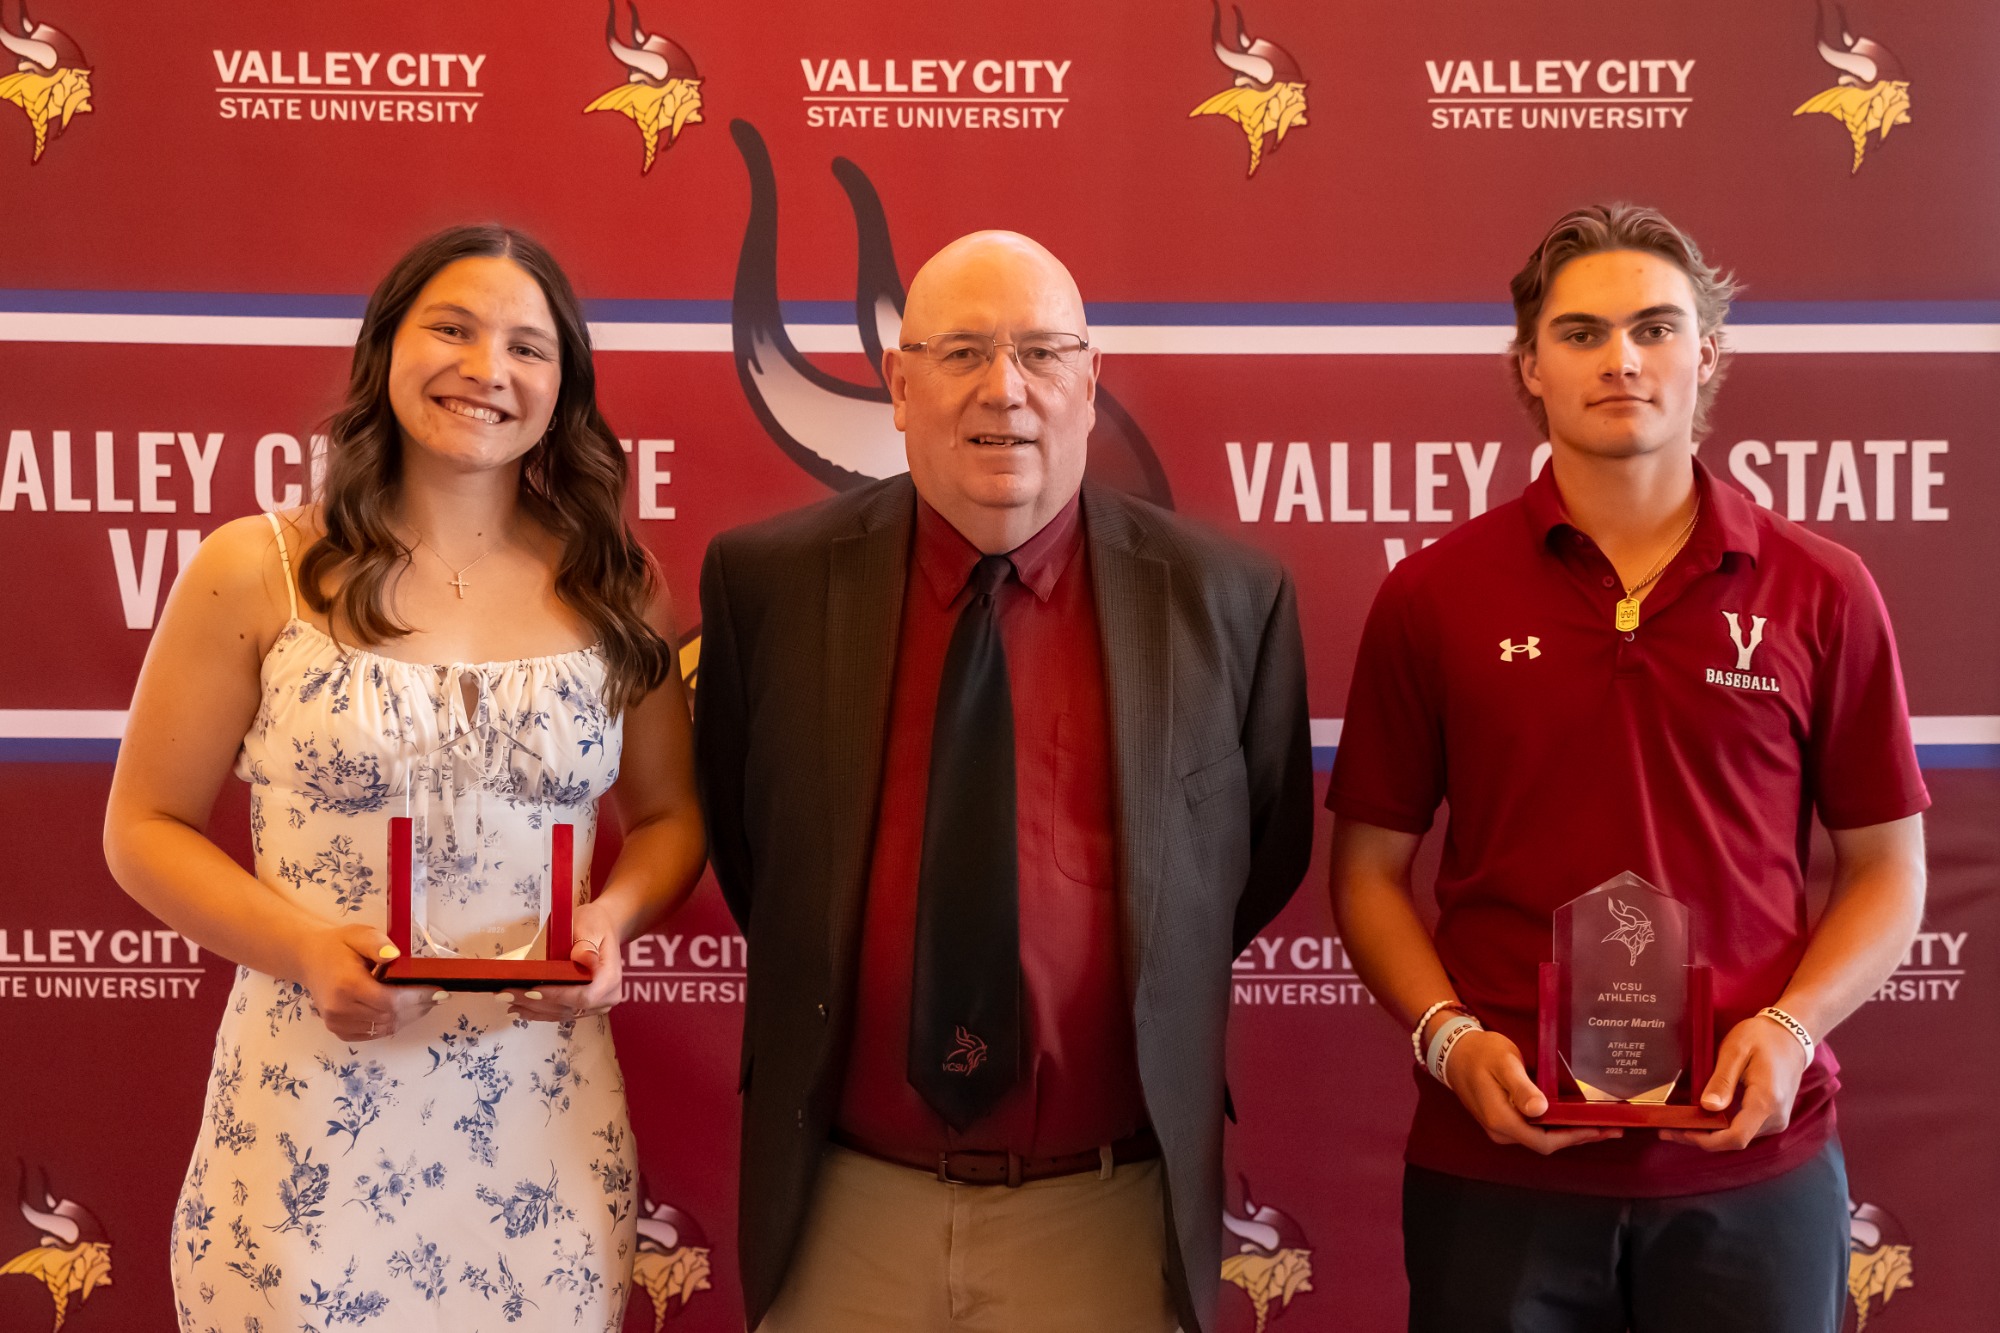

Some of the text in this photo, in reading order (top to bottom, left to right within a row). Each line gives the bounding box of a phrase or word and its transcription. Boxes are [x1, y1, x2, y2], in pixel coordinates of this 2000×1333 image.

[213, 50, 486, 88] VALLEY CITY
[800, 58, 1071, 93] VALLEY CITY
[1425, 60, 1696, 93] VALLEY CITY
[219, 97, 478, 123] STATE UNIVERSITY
[806, 106, 1064, 129] STATE UNIVERSITY
[1431, 107, 1688, 129] STATE UNIVERSITY
[0, 429, 328, 514] ALLEY CI
[1225, 441, 1502, 523] VALLEY
[1728, 440, 1949, 521] STATE
[1706, 668, 1780, 692] BASEBALL
[0, 929, 104, 963] LLEY
[689, 934, 748, 968] CIT
[35, 977, 200, 999] UNIVERSITY
[1234, 984, 1377, 1005] NIVERSIT
[1597, 993, 1657, 1003] ATHLETICS
[1612, 982, 1642, 992] VCSU
[1867, 980, 1960, 1002] RSITY
[1588, 1017, 1666, 1029] Connor Martin
[1436, 1023, 1472, 1080] AWLESS
[1607, 1041, 1646, 1050] ATHLETE
[1611, 1050, 1642, 1058] OF THE
[942, 1062, 968, 1072] VCSU
[1605, 1067, 1623, 1075] 2025
[1629, 1068, 1648, 1076] 2026
[1615, 1059, 1638, 1067] YEAR
